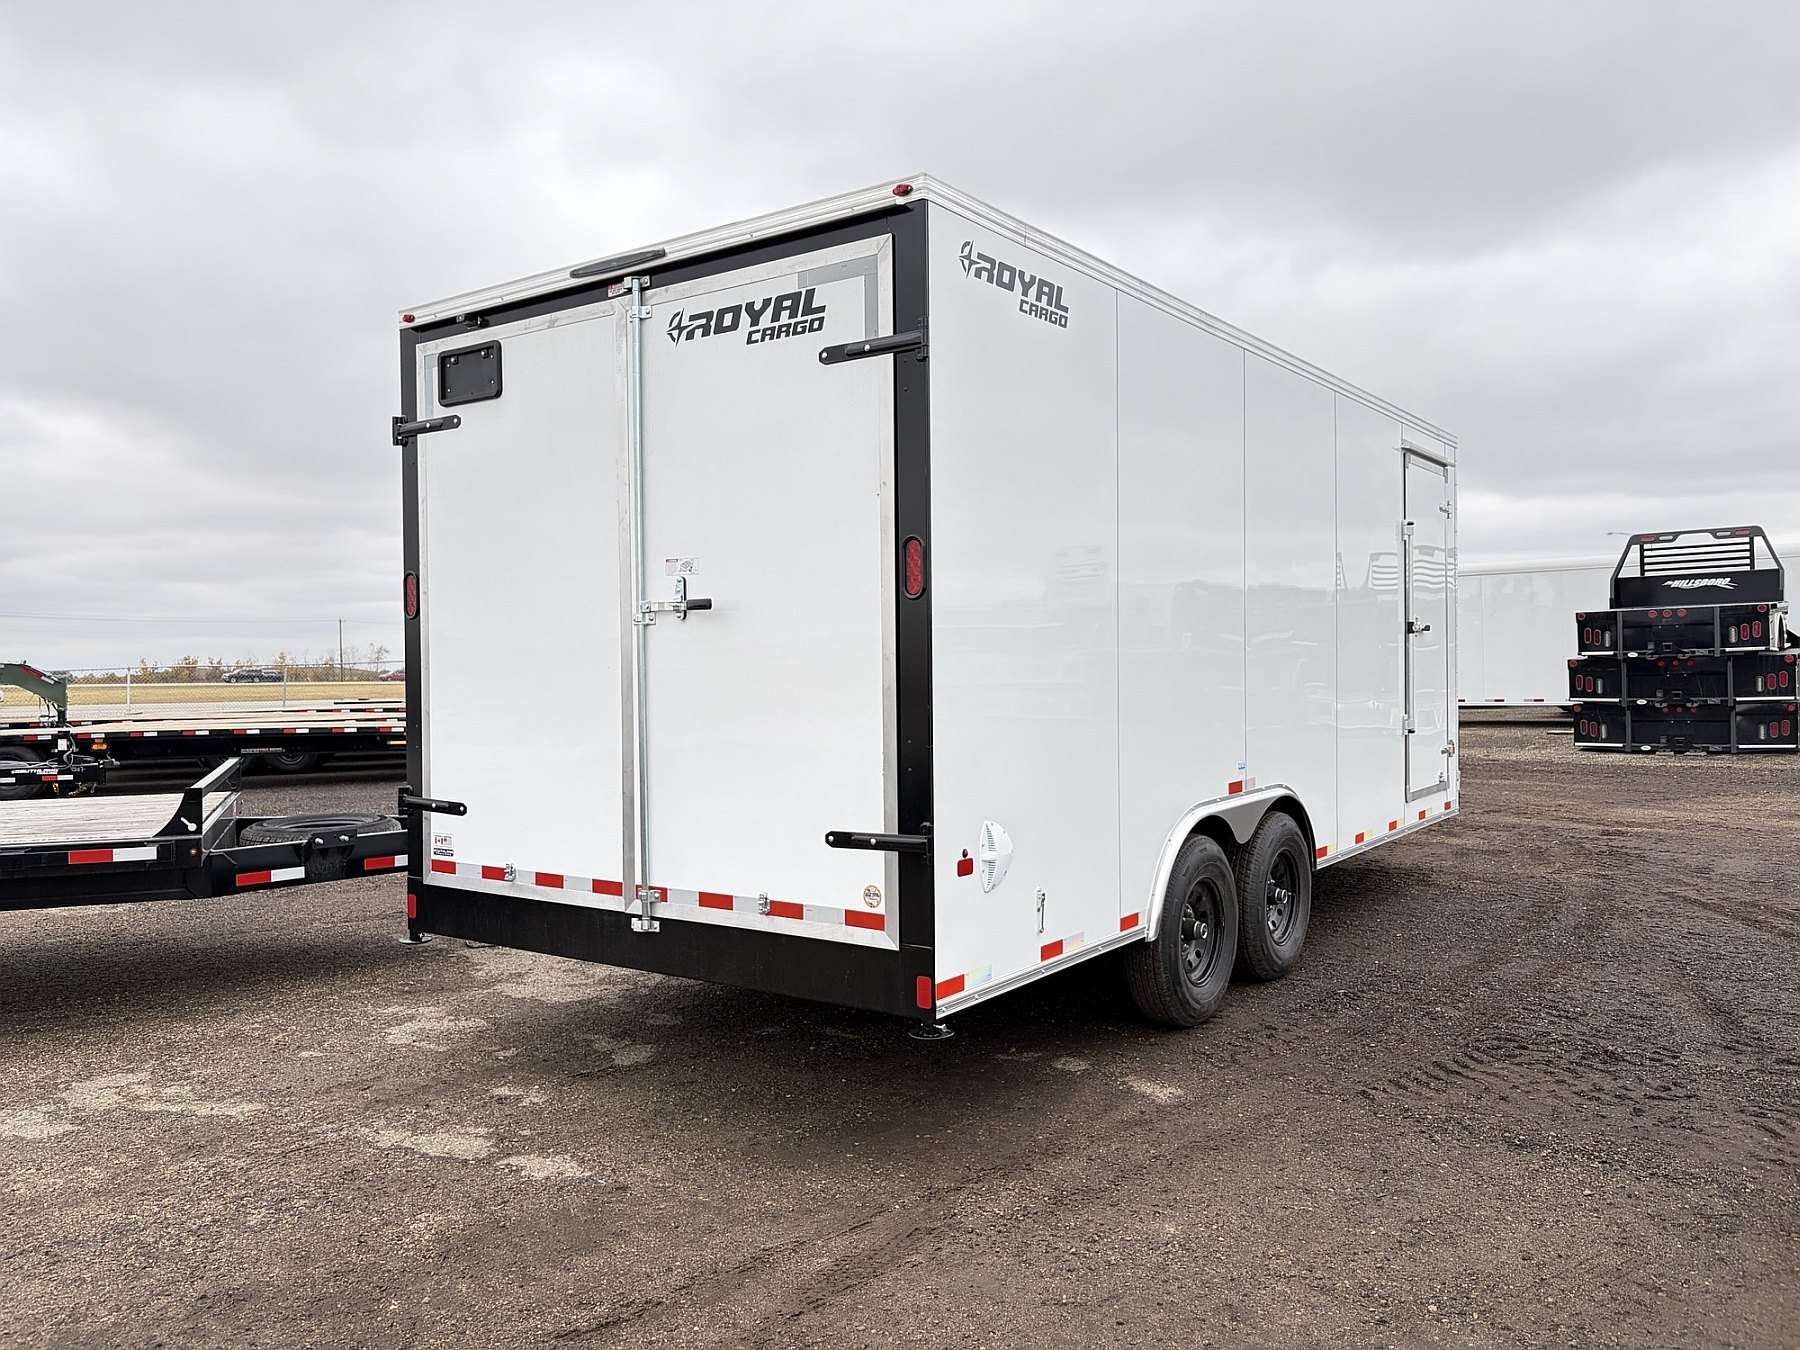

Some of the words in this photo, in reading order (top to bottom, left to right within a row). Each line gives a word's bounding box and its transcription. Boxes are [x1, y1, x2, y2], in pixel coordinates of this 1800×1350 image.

[974, 251, 1069, 314] ROYAL
[685, 288, 827, 341] ROYAL
[1019, 298, 1068, 328] CARGO
[745, 316, 825, 345] CARGO
[1670, 577, 1731, 588] HILLSBORO
